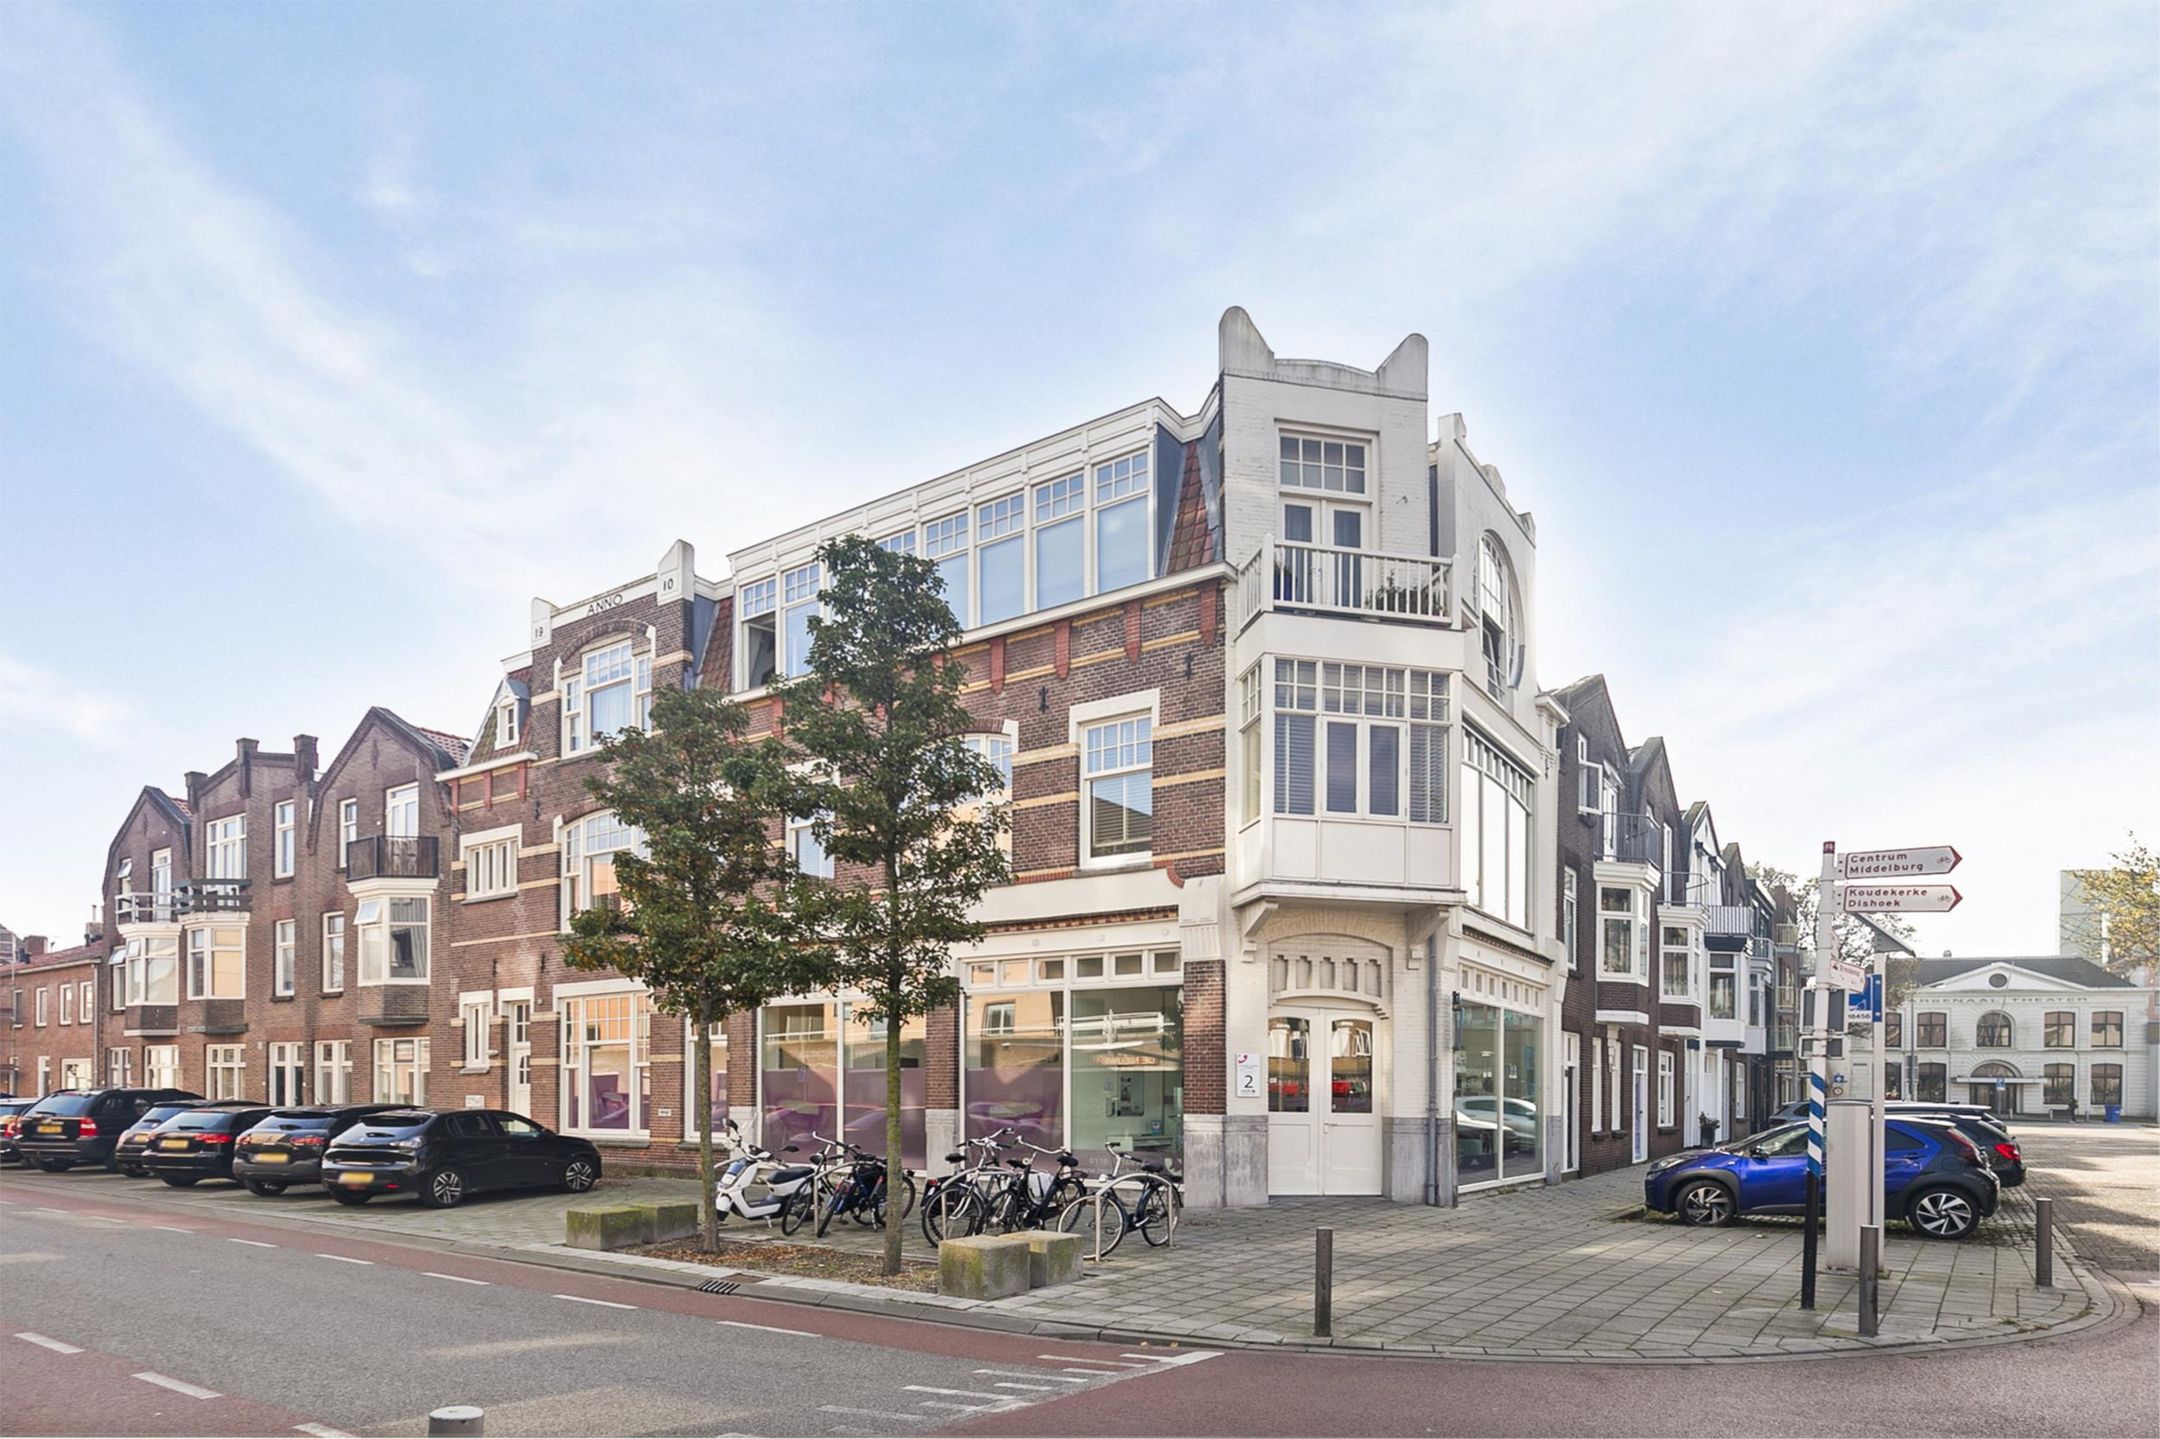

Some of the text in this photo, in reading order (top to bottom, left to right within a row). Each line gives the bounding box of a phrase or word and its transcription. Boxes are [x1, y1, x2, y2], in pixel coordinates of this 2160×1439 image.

[663, 578, 674, 592] 10
[586, 594, 623, 616] ANNO
[1850, 853, 1907, 863] Centrum
[1850, 863, 1924, 874] Middelburg
[1849, 888, 1928, 897] Koudekerke
[1848, 899, 1901, 907] Dishoek
[1244, 1074, 1254, 1089] 2
